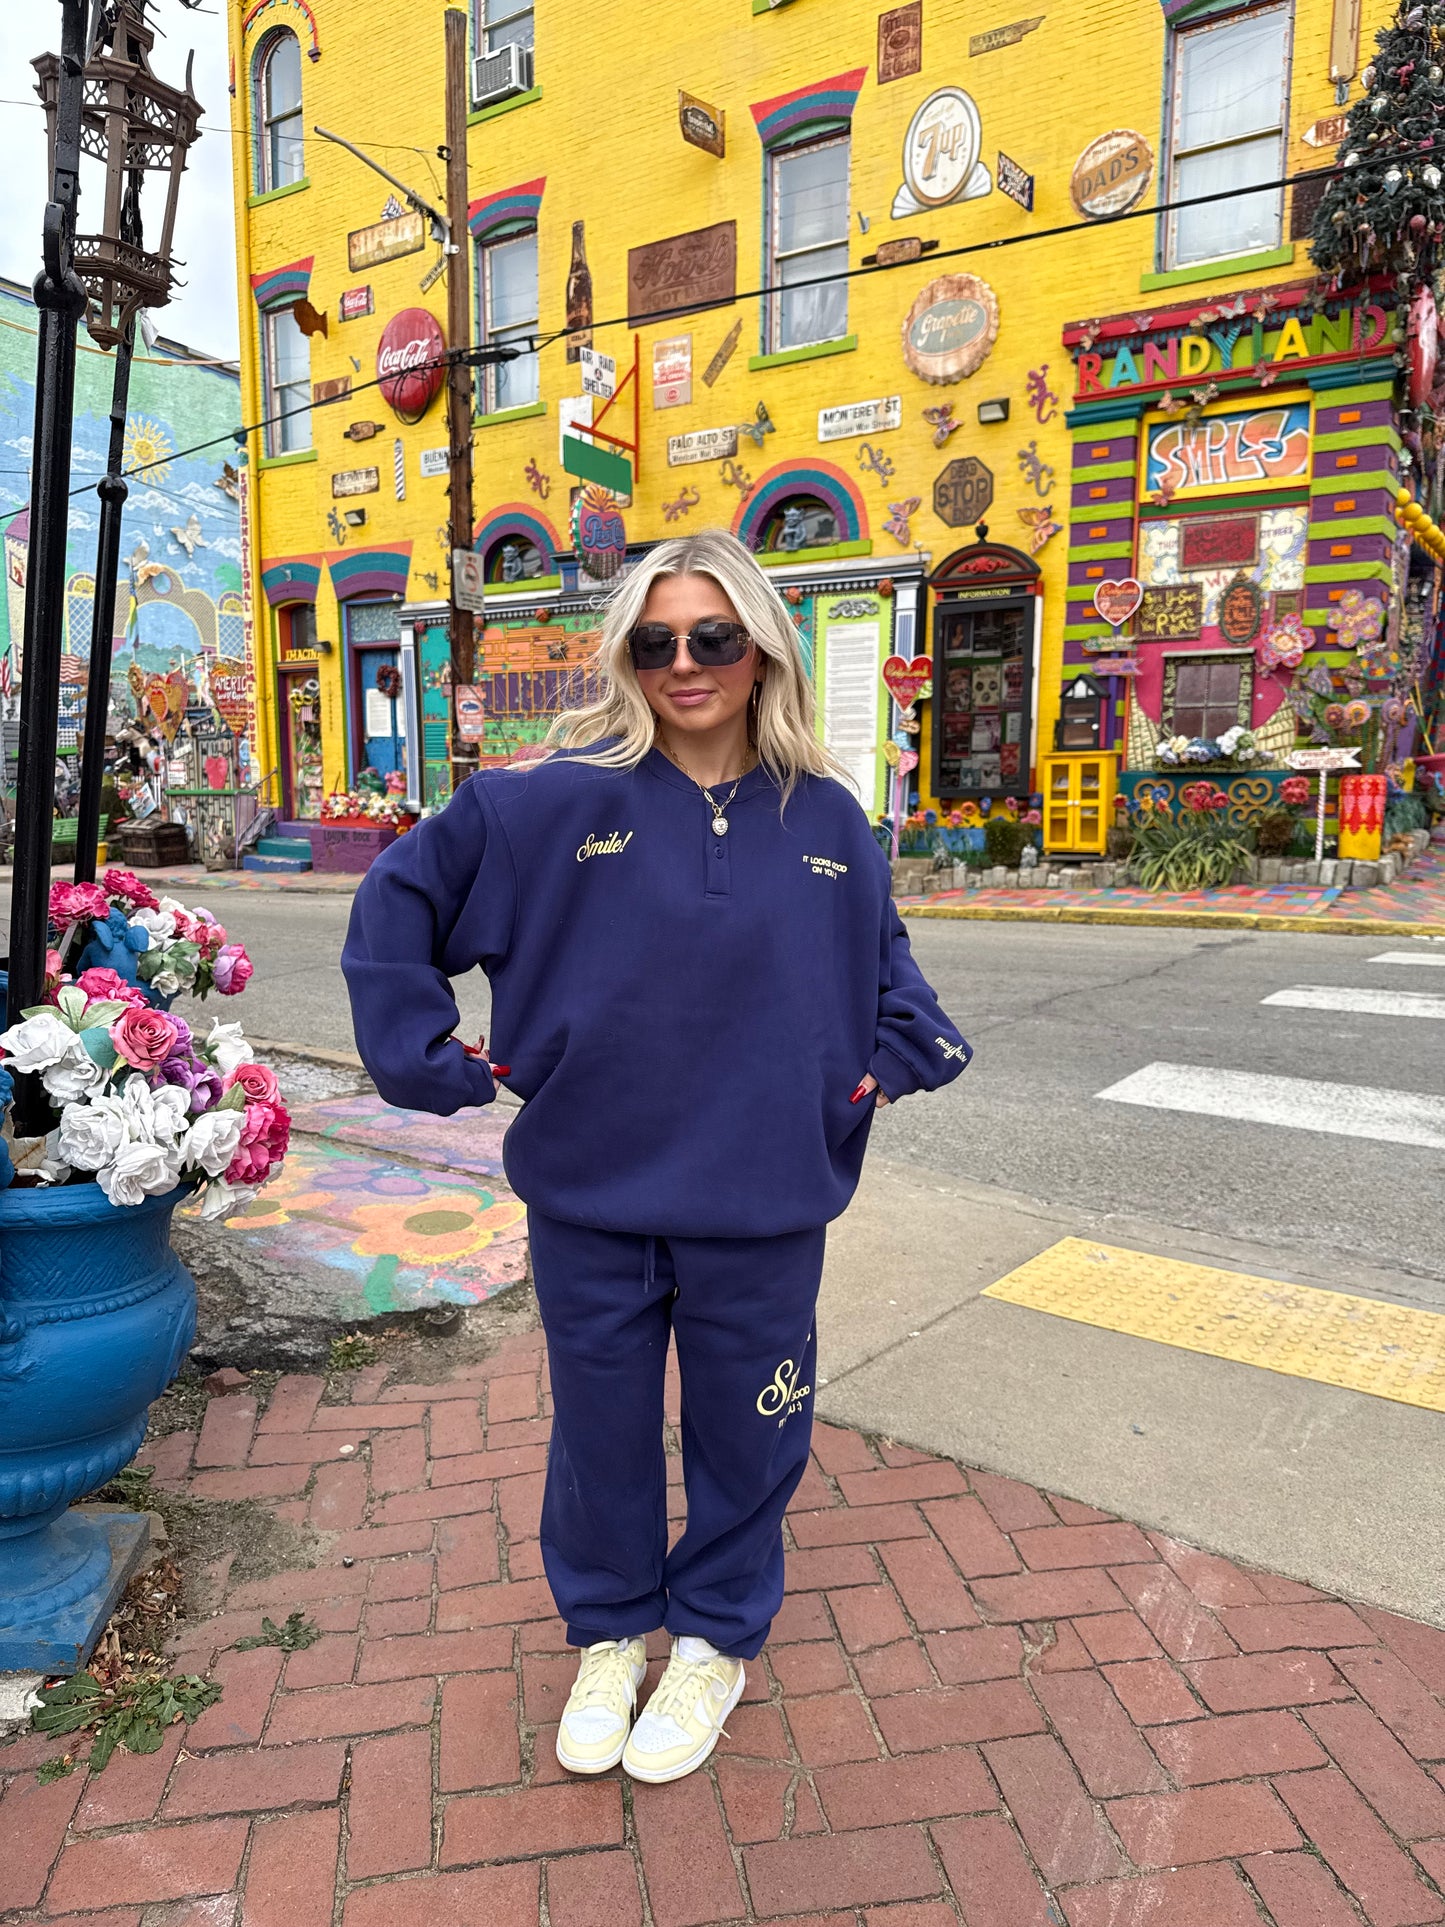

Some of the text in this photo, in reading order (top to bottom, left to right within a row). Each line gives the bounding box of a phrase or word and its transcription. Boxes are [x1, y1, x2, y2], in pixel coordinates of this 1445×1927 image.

[1081, 147, 1139, 199] DAD'S
[379, 338, 433, 375] Coca-Cola
[580, 348, 615, 373] AIR RAID
[583, 376, 614, 399] SHELTER
[671, 434, 694, 449] PALO
[696, 432, 718, 446] ALTO
[937, 477, 988, 508] STOP
[239, 473, 251, 612] INTERNATIONAL
[957, 588, 1011, 600] INFORMATION
[243, 620, 257, 692] WELCOME
[285, 648, 320, 661] IMAGIN
[215, 676, 247, 691] AMERIC
[248, 701, 257, 753] HOUSE
[576, 831, 633, 862] Smile!
[802, 855, 848, 873] IT LOOKS GOOD
[812, 866, 823, 874] ON
